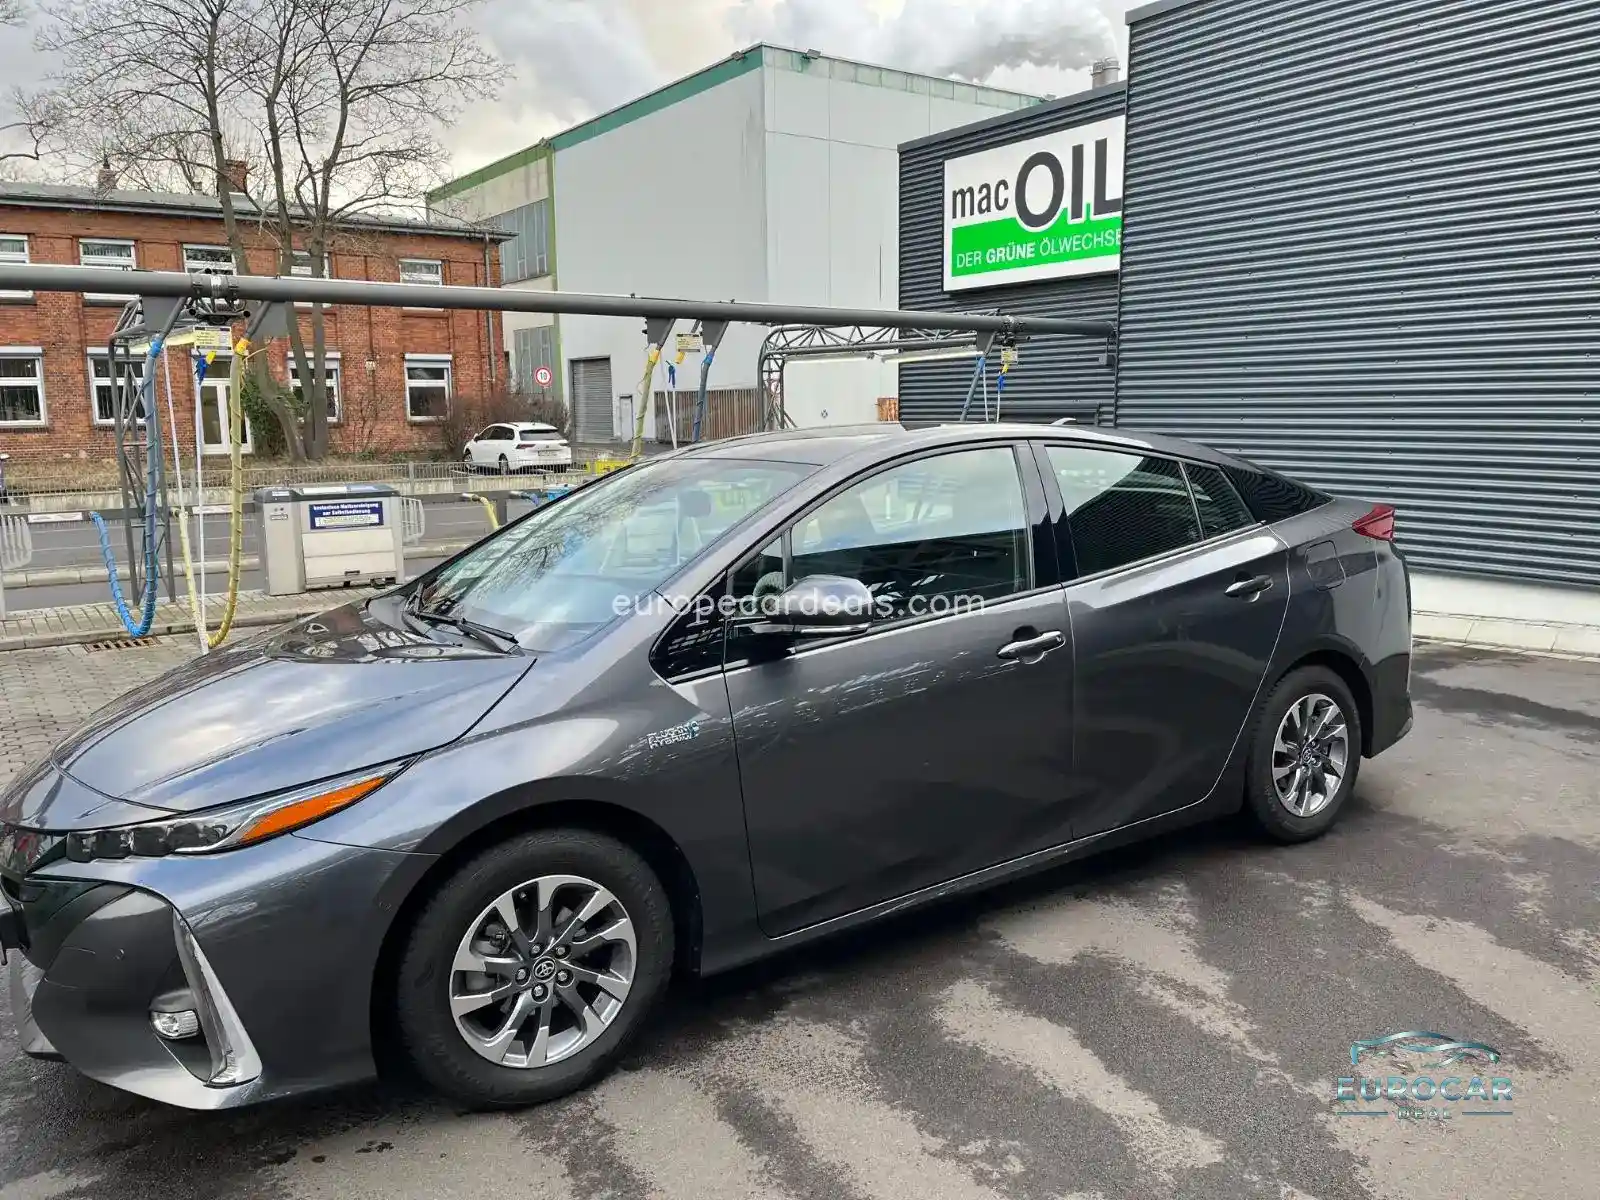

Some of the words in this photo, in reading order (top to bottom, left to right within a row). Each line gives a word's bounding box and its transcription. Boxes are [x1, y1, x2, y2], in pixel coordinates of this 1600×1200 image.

[952, 179, 1009, 219] mac
[1015, 138, 1122, 228] OIL
[956, 251, 982, 269] DER
[986, 241, 1036, 264] GRÜNE
